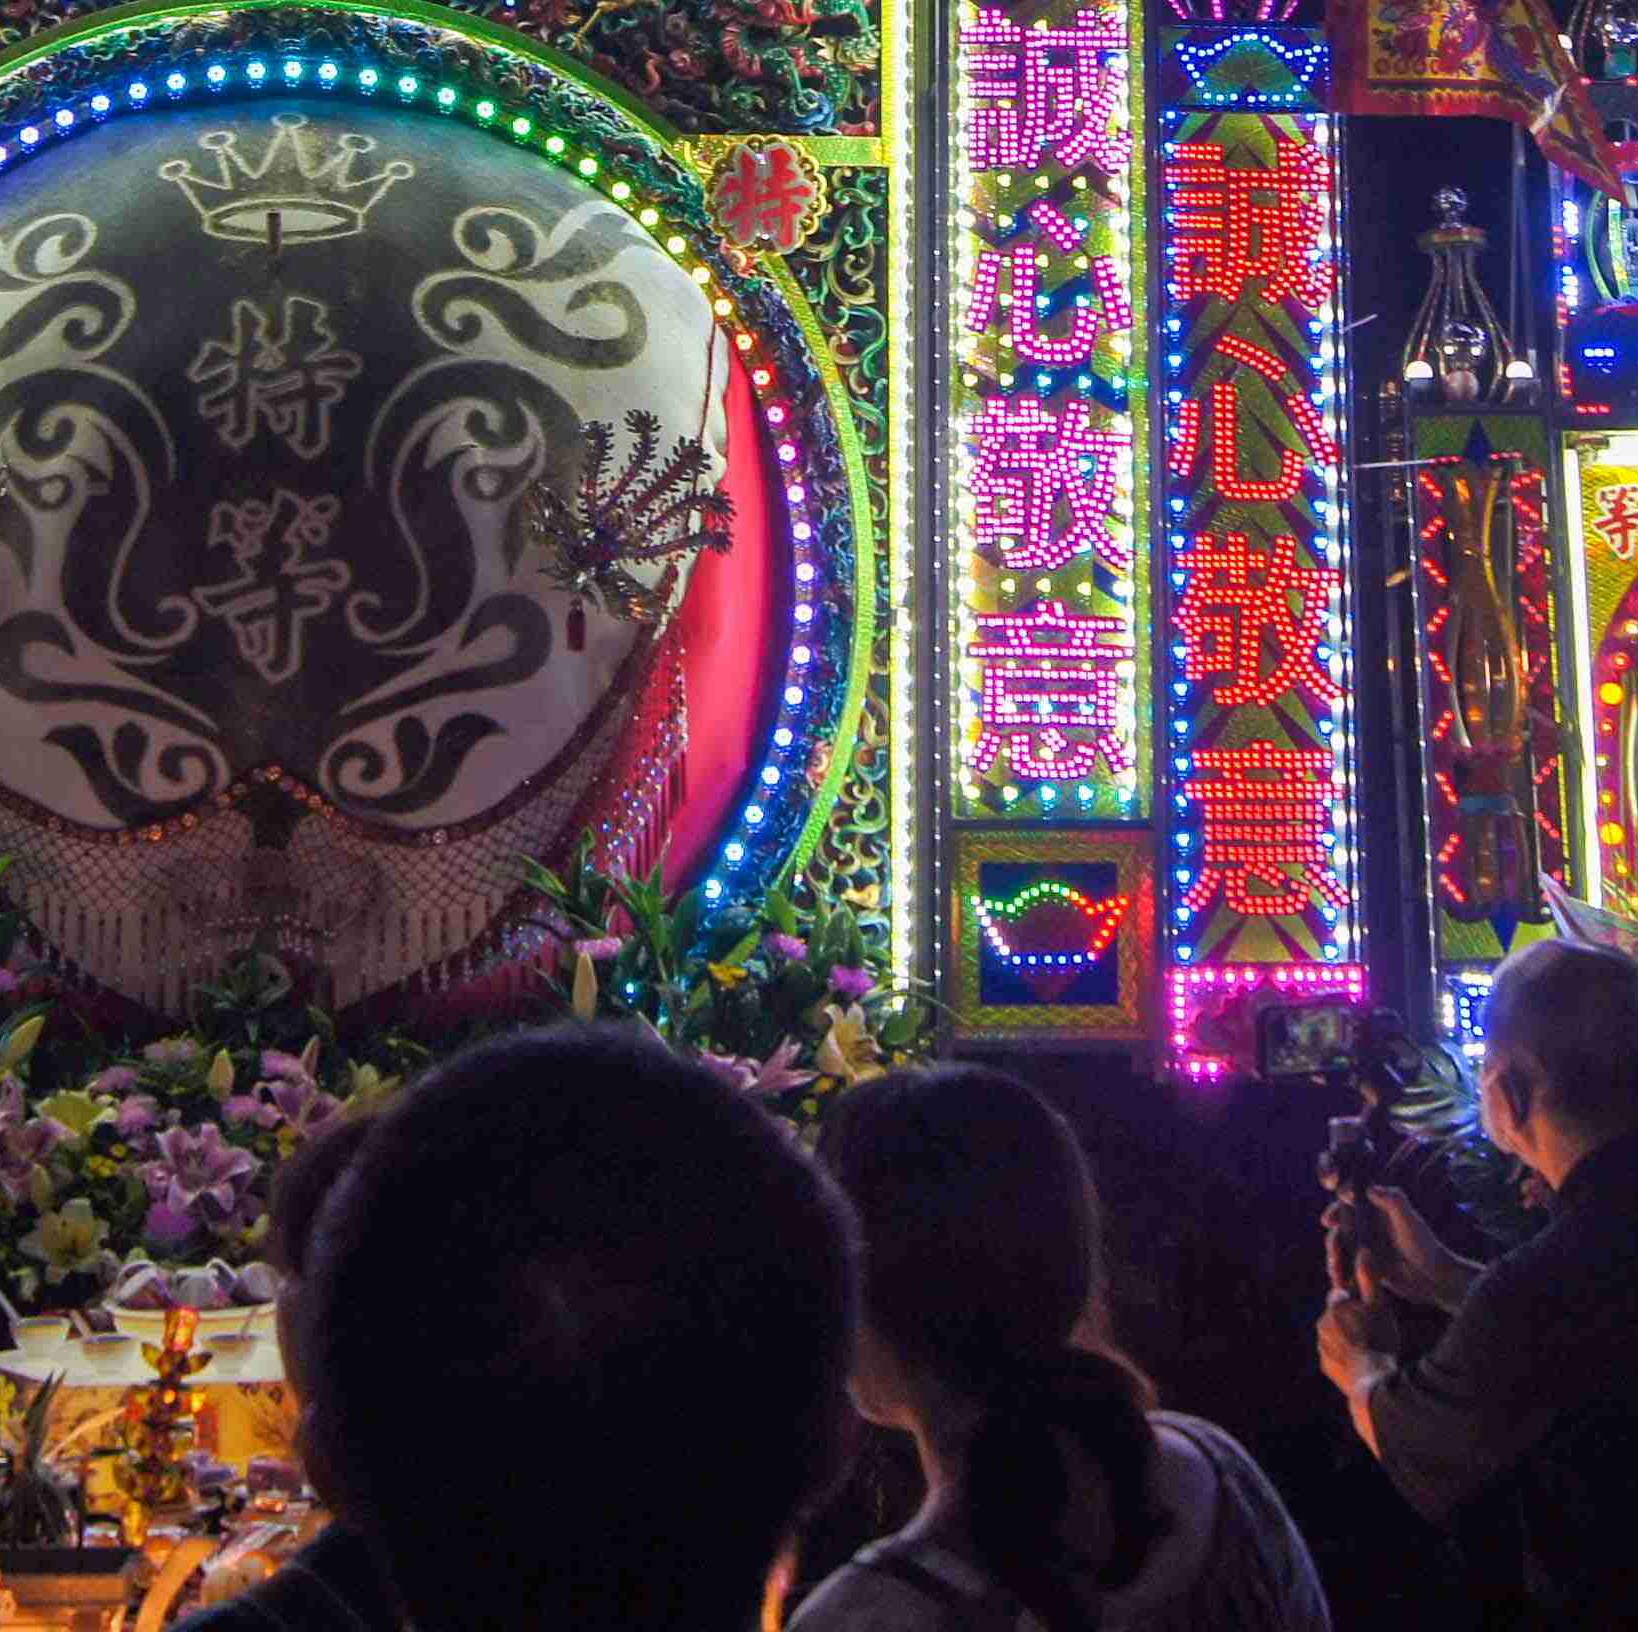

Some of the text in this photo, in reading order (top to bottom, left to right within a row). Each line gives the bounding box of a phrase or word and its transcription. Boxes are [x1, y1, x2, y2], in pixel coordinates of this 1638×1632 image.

[960, 8, 1134, 779] 誠心敬意
[1164, 141, 1349, 916] 誠心敬意
